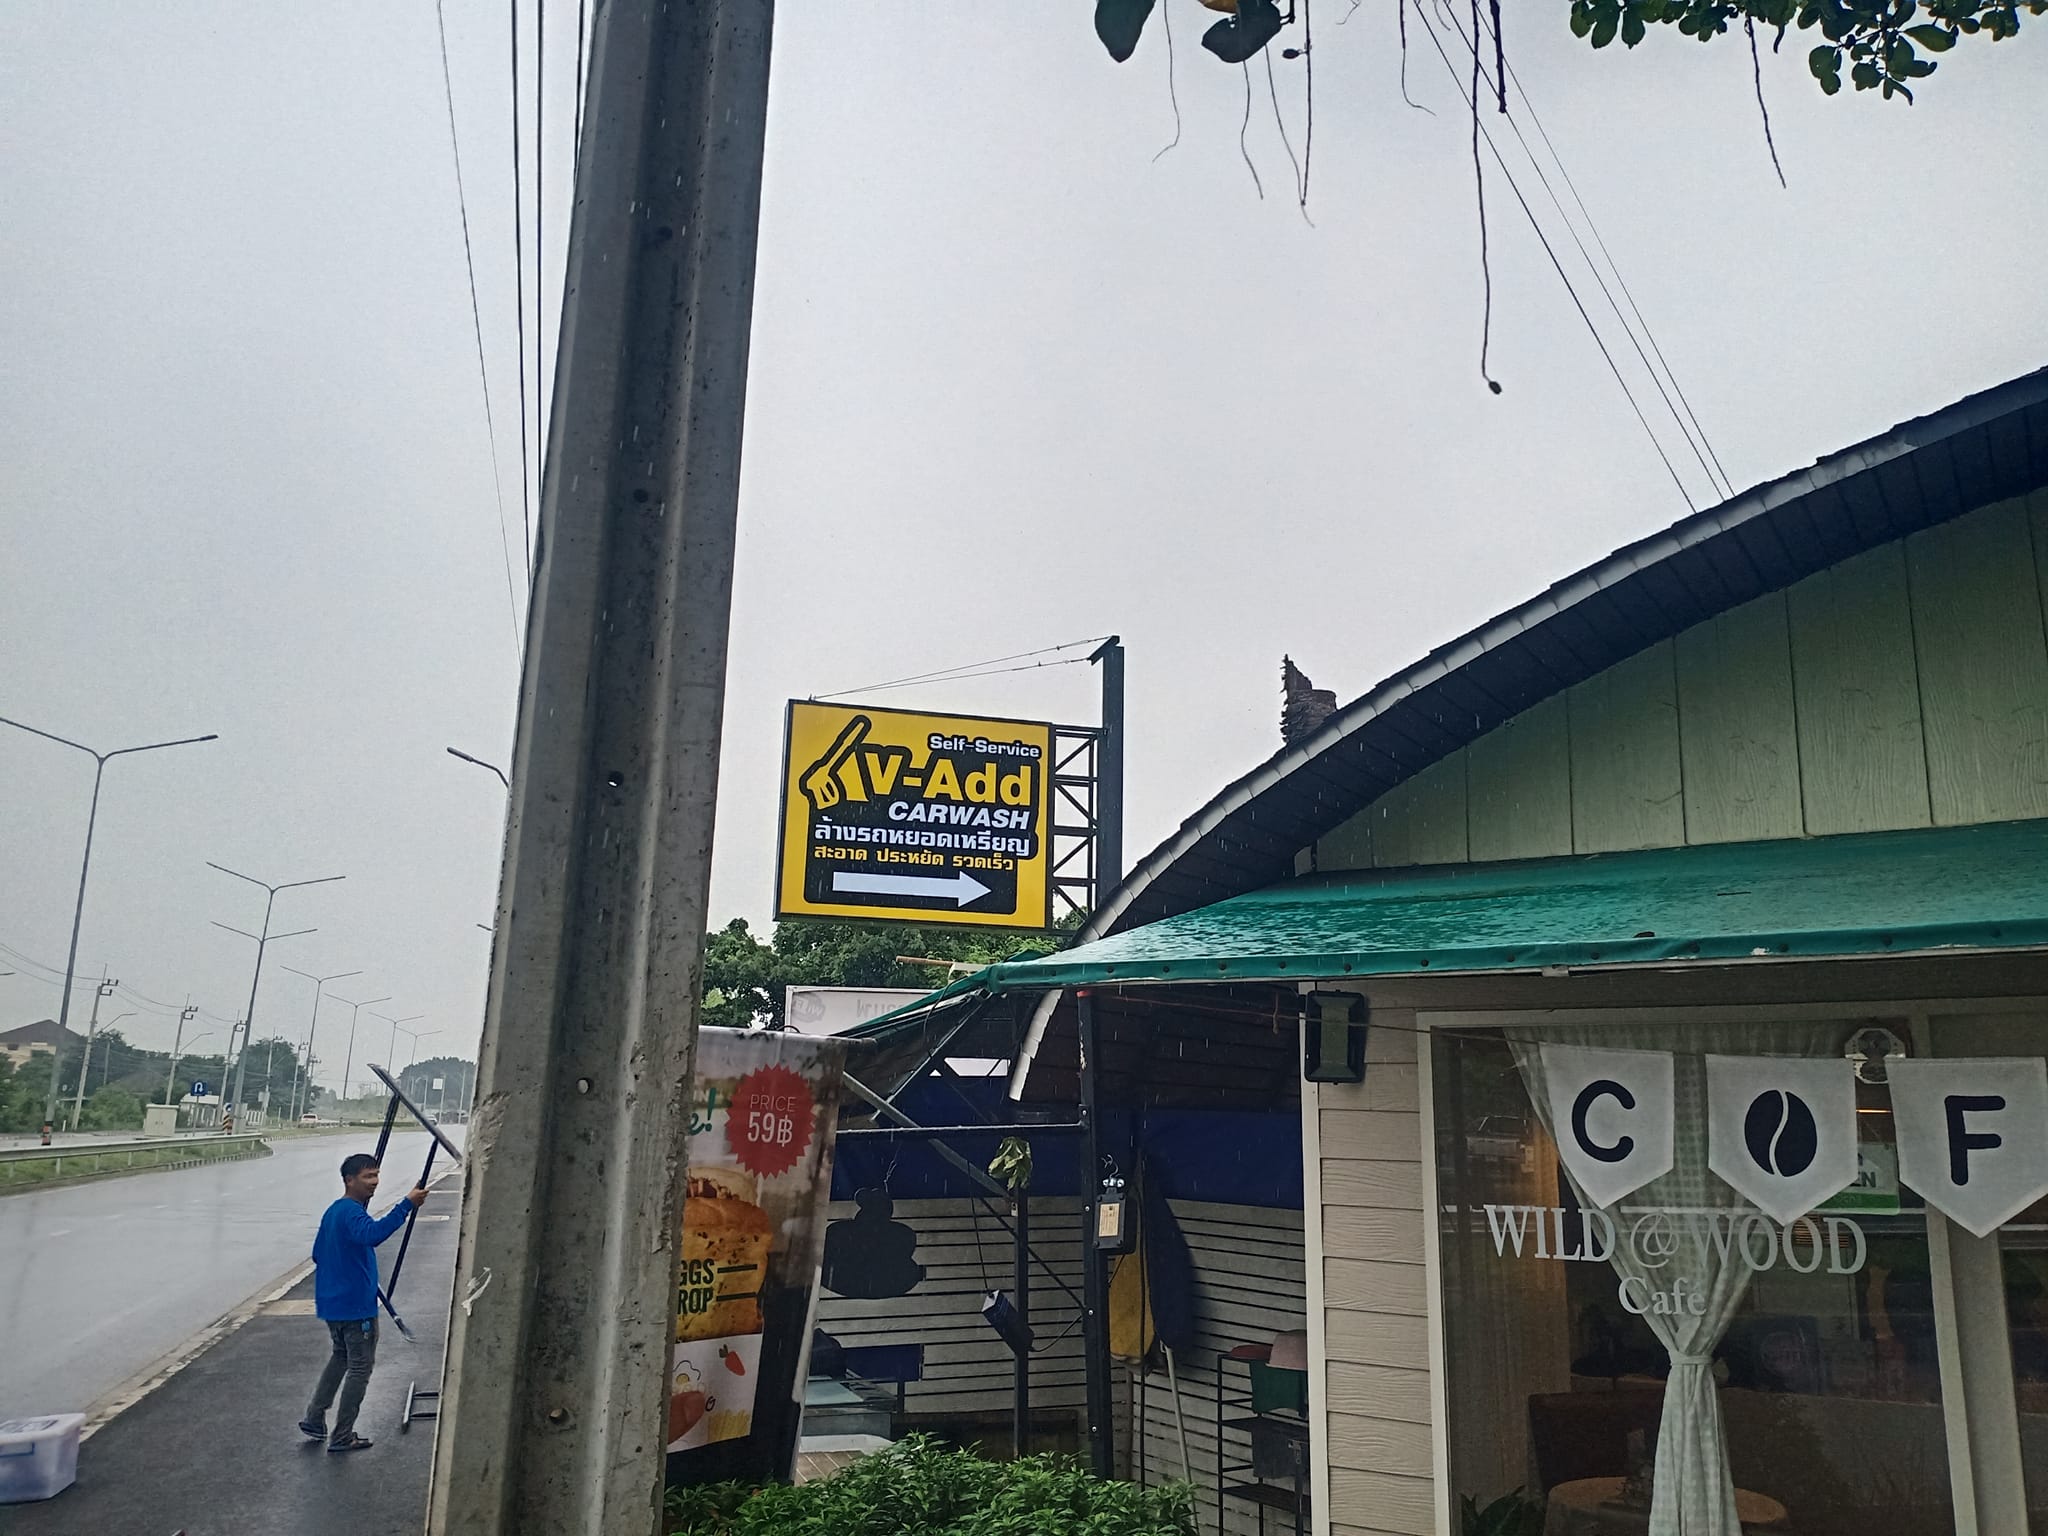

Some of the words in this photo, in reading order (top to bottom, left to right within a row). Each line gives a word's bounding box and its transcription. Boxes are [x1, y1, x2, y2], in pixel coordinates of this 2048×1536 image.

[929, 735, 1040, 758] Self-Service
[888, 801, 1030, 830] CARWASH
[814, 816, 1030, 857] ล้างรถหยอดเหรียญ
[814, 845, 868, 861] สะอาด
[876, 847, 944, 866] ประหยัด
[952, 853, 1014, 871] รวดเร็ว
[750, 1094, 797, 1112] PRICE
[1483, 1203, 1616, 1263] WILD
[1630, 1211, 1680, 1269] @
[1692, 1211, 1867, 1275] WOOD
